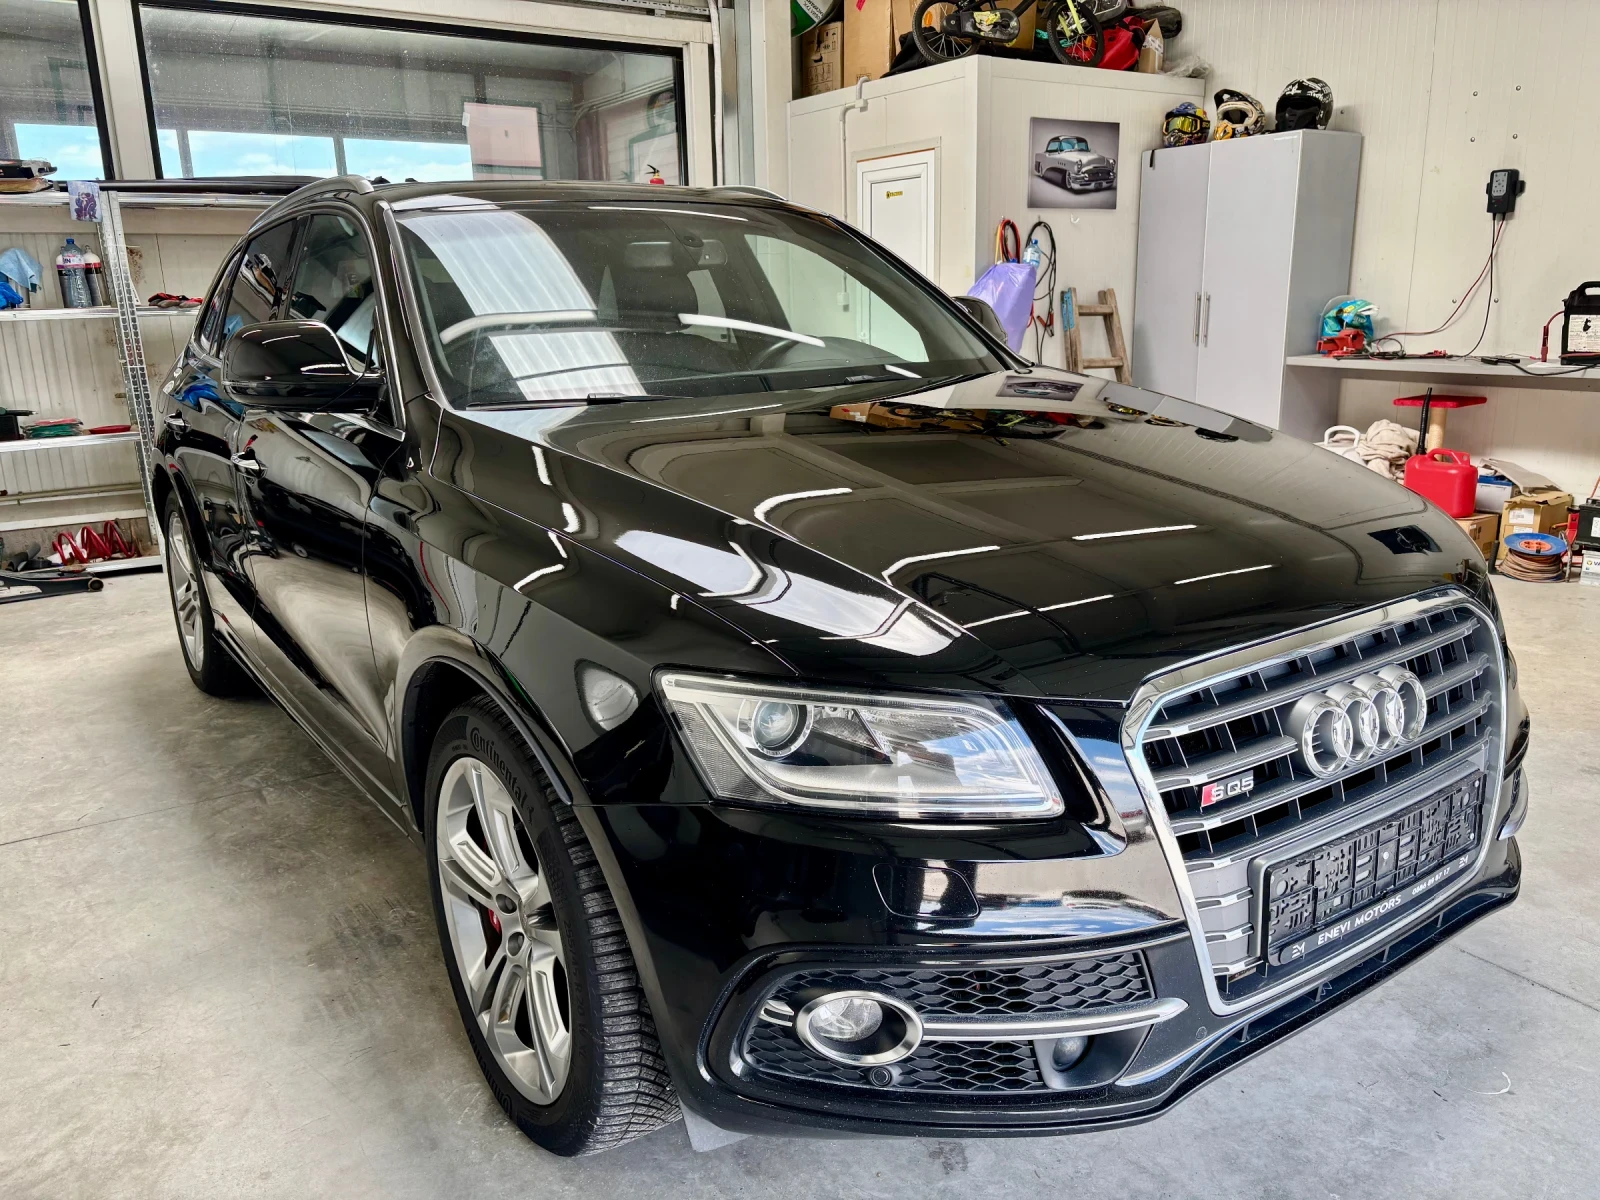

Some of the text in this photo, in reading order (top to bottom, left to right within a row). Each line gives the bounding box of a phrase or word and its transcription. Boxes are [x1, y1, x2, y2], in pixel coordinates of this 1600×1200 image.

[470, 727, 528, 809] Continental
[1317, 920, 1350, 945] ENEVI
[1354, 895, 1401, 927] MOTORS
